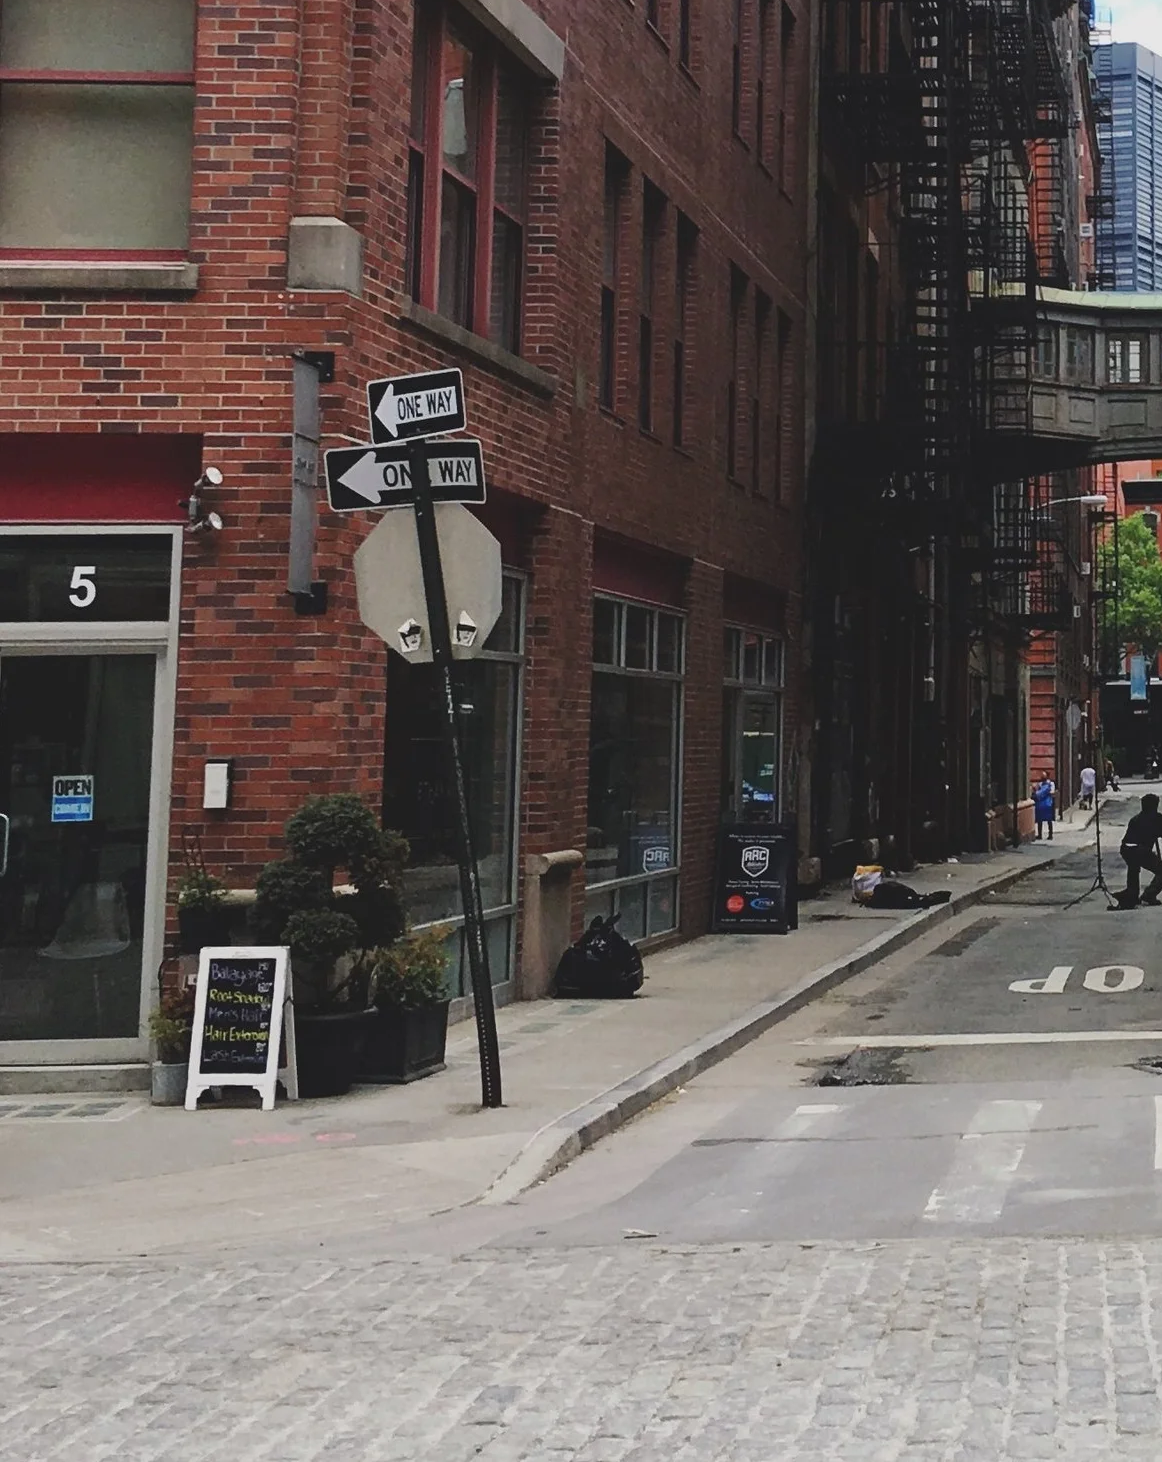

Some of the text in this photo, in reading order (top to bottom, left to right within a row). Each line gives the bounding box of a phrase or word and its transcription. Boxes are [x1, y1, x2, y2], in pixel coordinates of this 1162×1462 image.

[397, 390, 452, 420] ONE WAY
[382, 460, 472, 487] ON WAY
[69, 566, 96, 608] 5
[55, 779, 92, 796] OPEN
